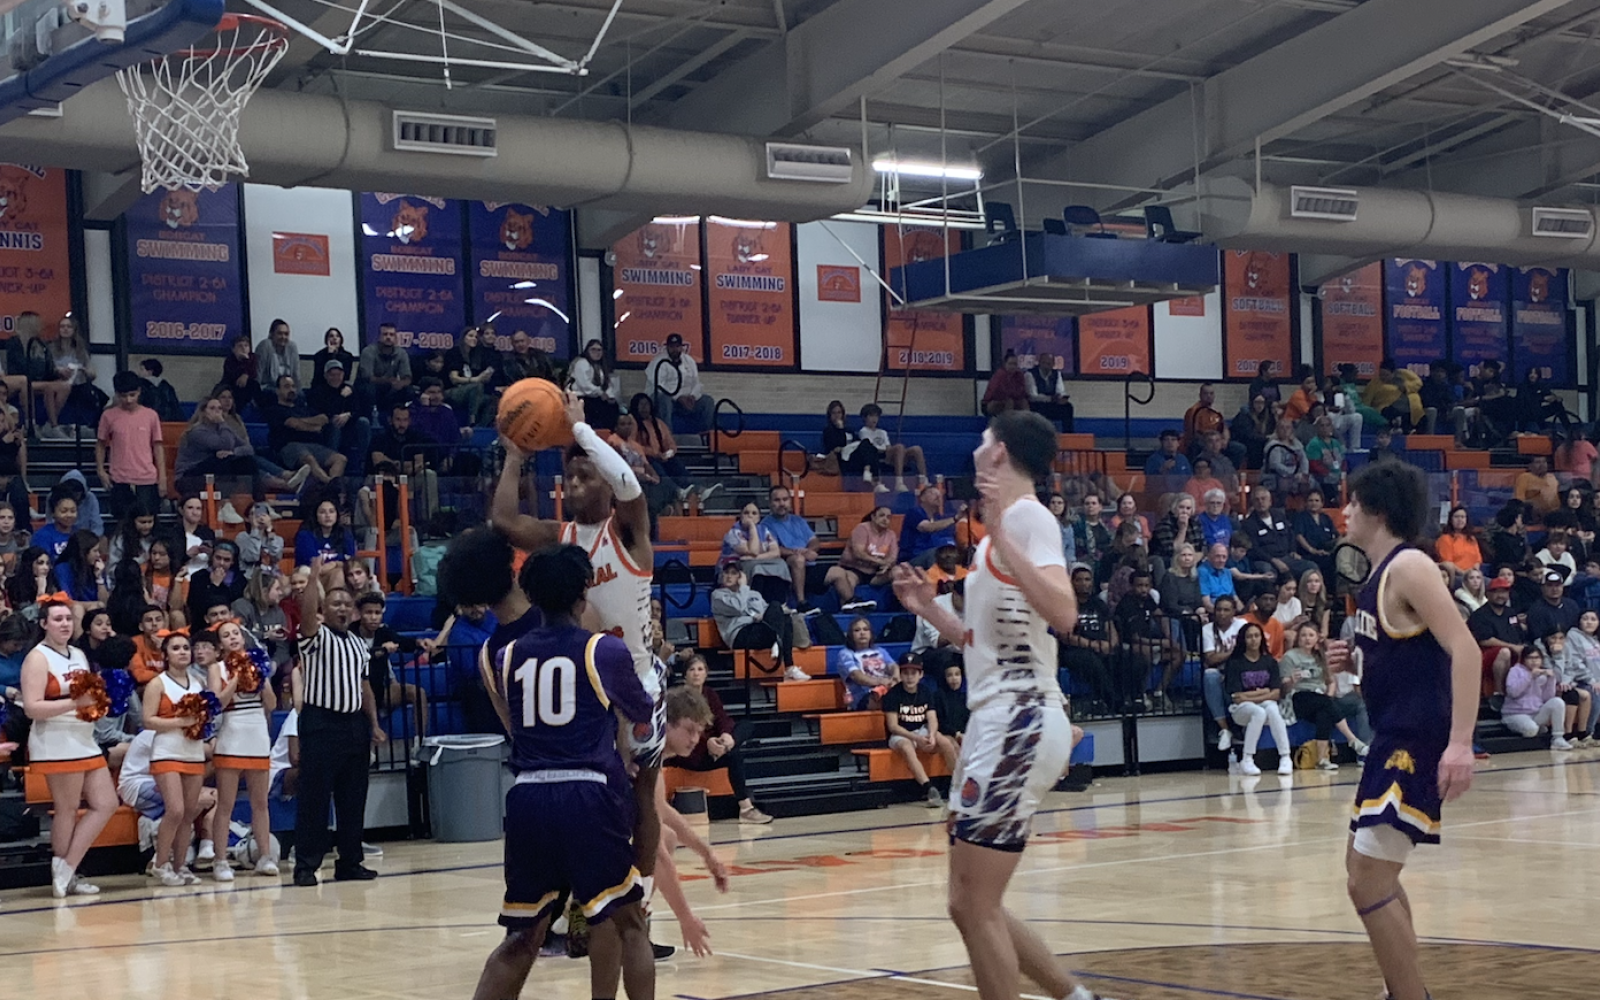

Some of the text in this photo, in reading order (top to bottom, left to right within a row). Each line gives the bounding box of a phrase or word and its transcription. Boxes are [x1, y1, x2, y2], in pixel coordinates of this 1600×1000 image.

[137, 239, 229, 262] SWIMMING
[372, 254, 455, 274] SWIMMING
[480, 260, 558, 280] SWIMMING
[622, 269, 694, 286] SWIMMING
[716, 274, 785, 292] SWIMMING
[153, 289, 217, 303] CHAMPION
[1232, 297, 1286, 313] SOFTBALL
[1328, 302, 1377, 316] SOFTBALL
[147, 321, 227, 340] 2016-2017
[396, 332, 454, 348] 17-2018
[722, 344, 783, 361] 2017-2018
[1100, 355, 1129, 370] 2019
[514, 656, 577, 728] 10
